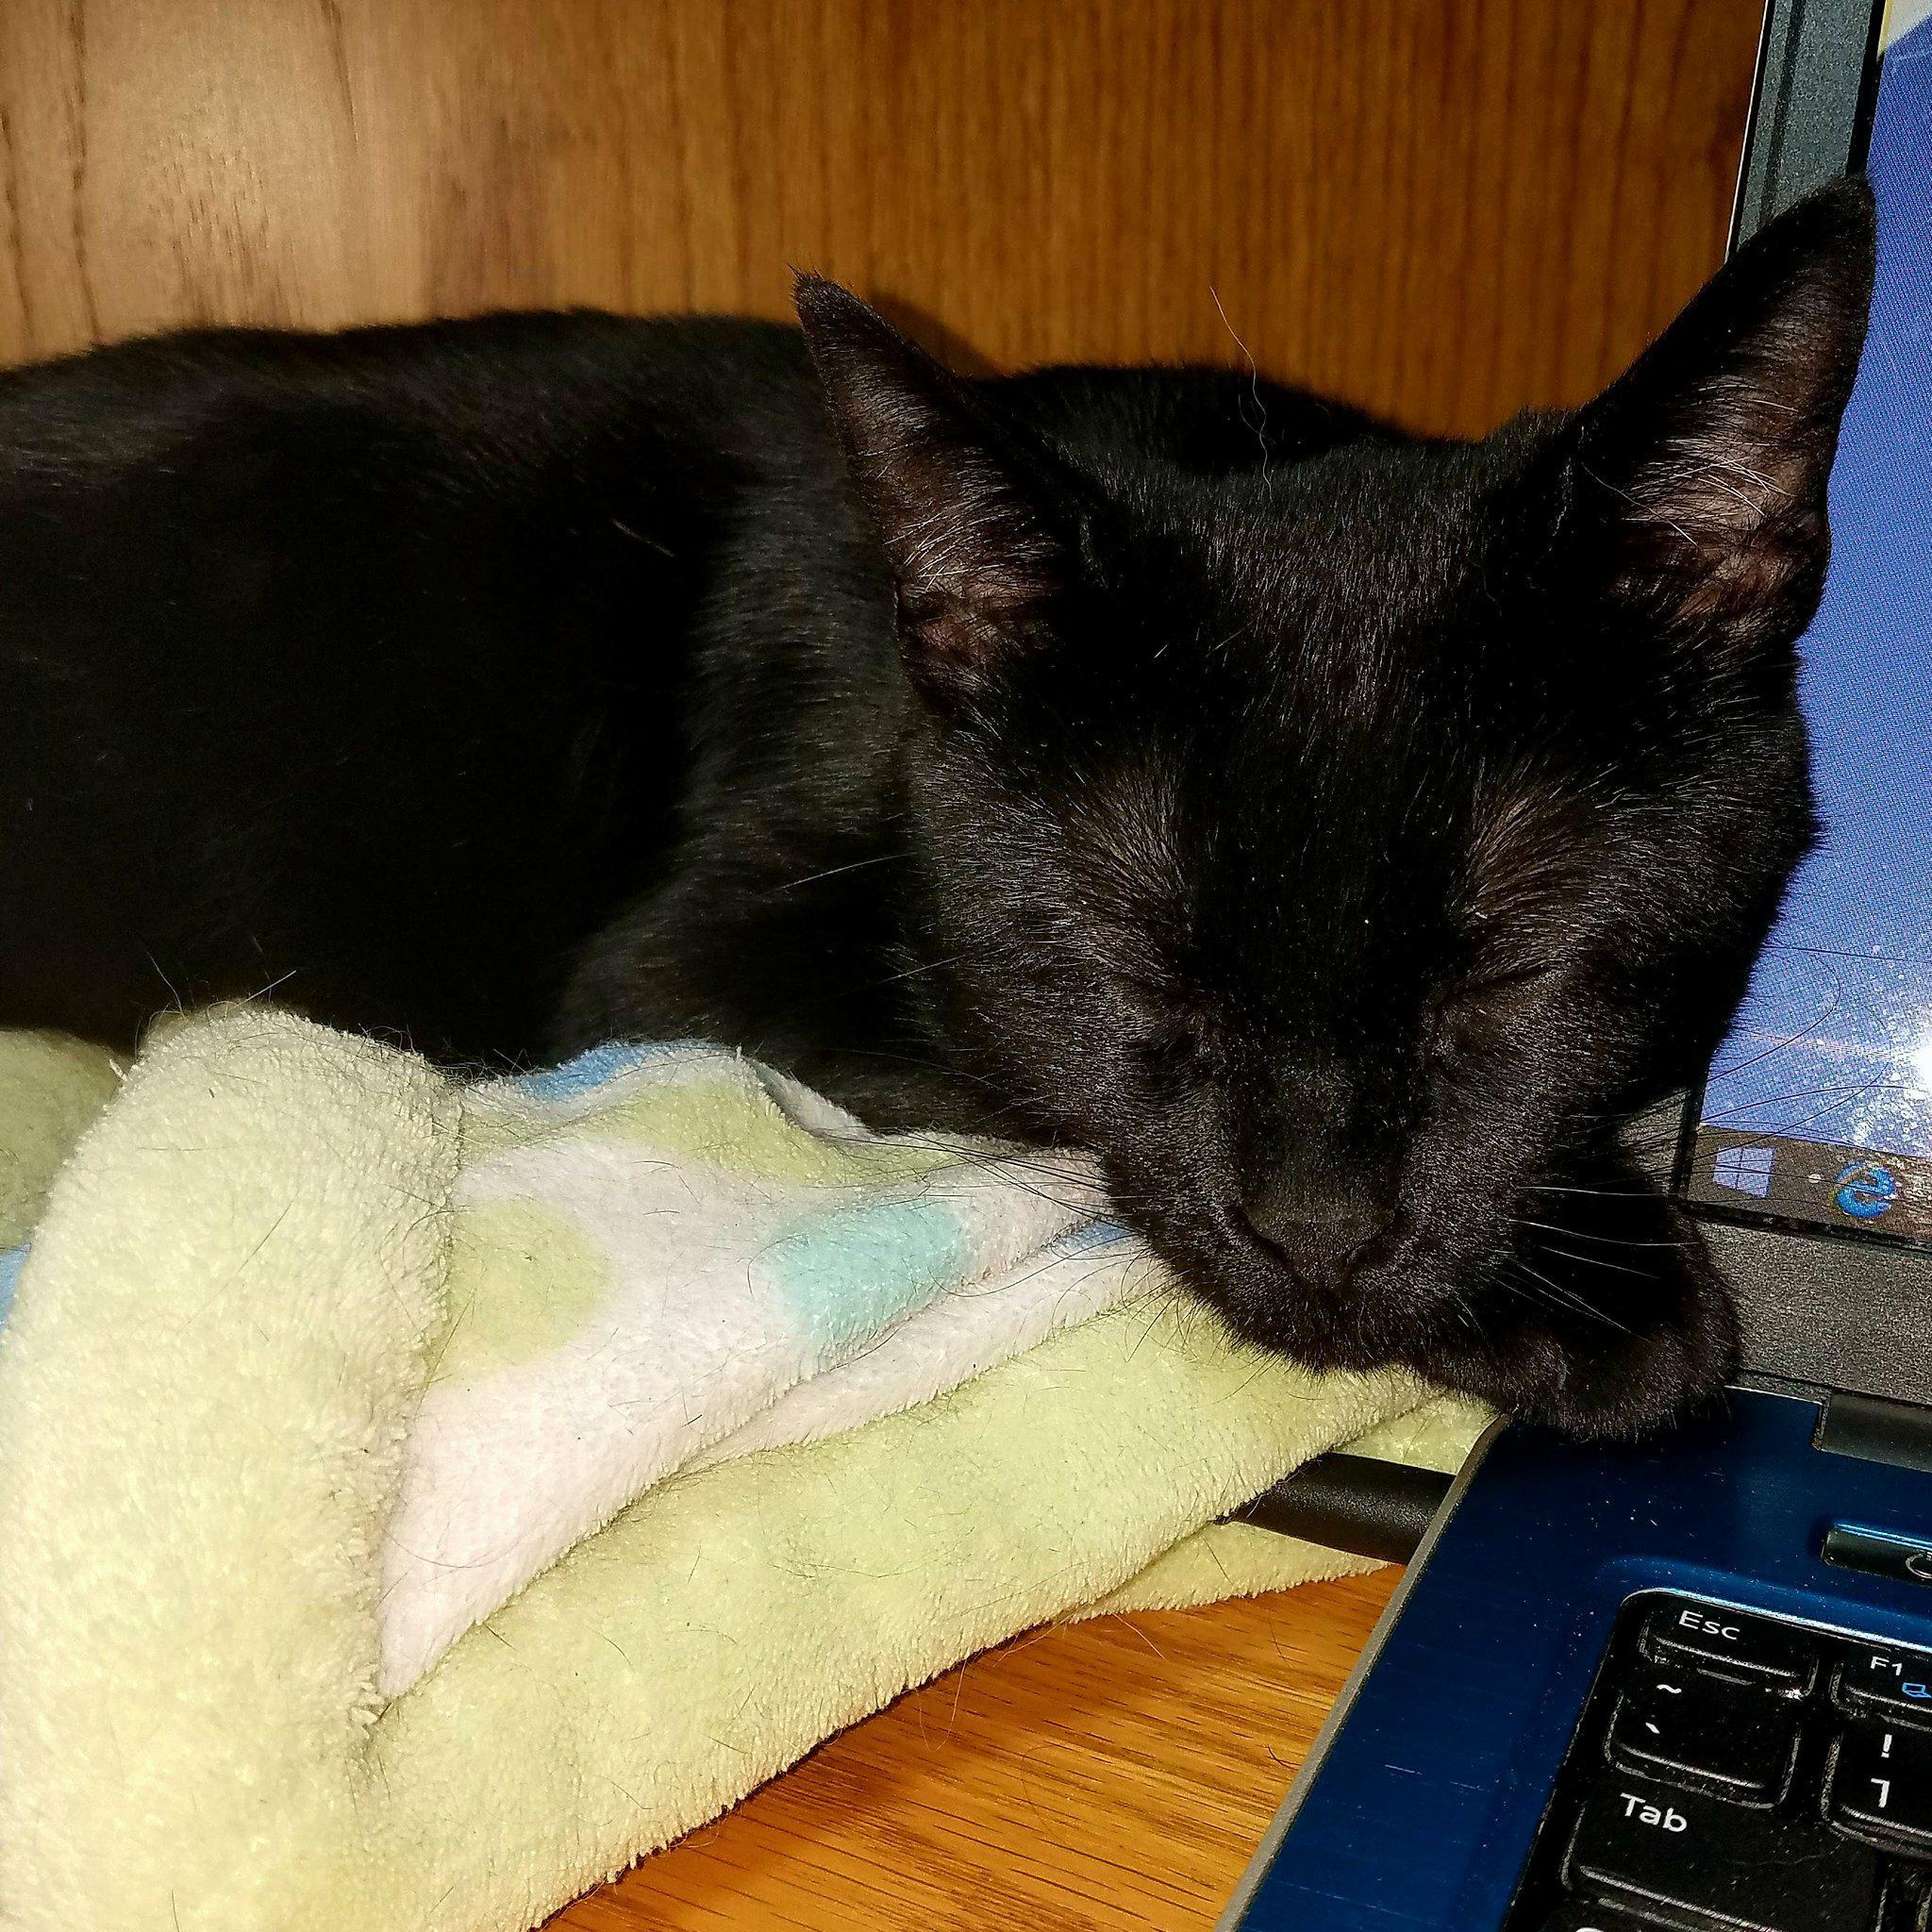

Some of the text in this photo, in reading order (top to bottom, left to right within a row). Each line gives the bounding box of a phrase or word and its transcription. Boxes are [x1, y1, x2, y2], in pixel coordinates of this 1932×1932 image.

[1678, 1610, 1740, 1641] Esc
[1870, 1656, 1903, 1676] F1
[1870, 1777, 1890, 1808] 1
[1620, 1792, 1688, 1833] Tab
